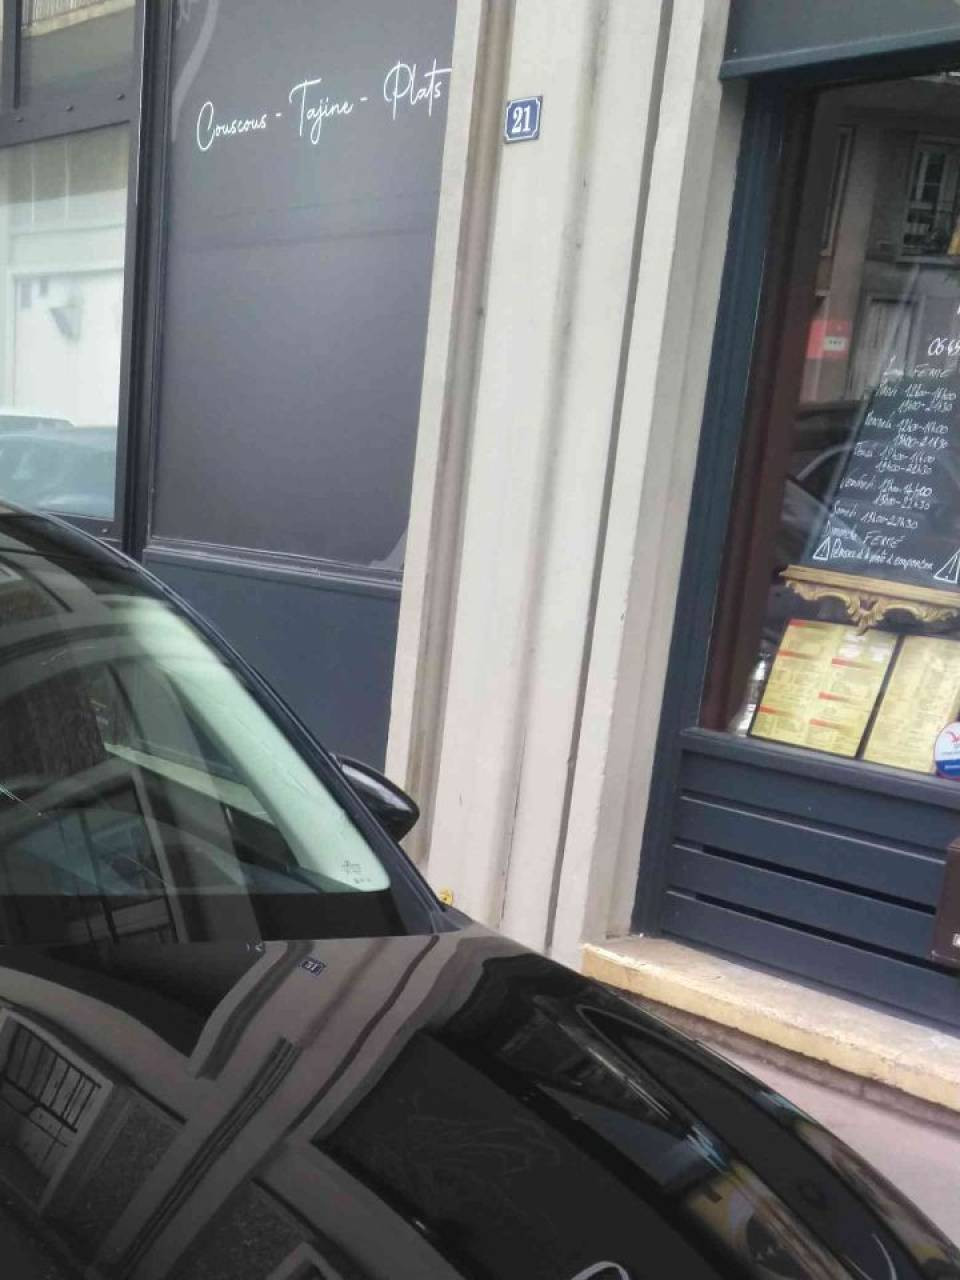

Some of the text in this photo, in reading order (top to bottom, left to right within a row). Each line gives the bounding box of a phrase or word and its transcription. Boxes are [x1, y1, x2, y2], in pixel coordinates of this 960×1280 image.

[196, 101, 267, 151] Couscous
[289, 78, 353, 145] Tajine
[383, 58, 452, 120] Plats
[511, 105, 531, 133] 21
